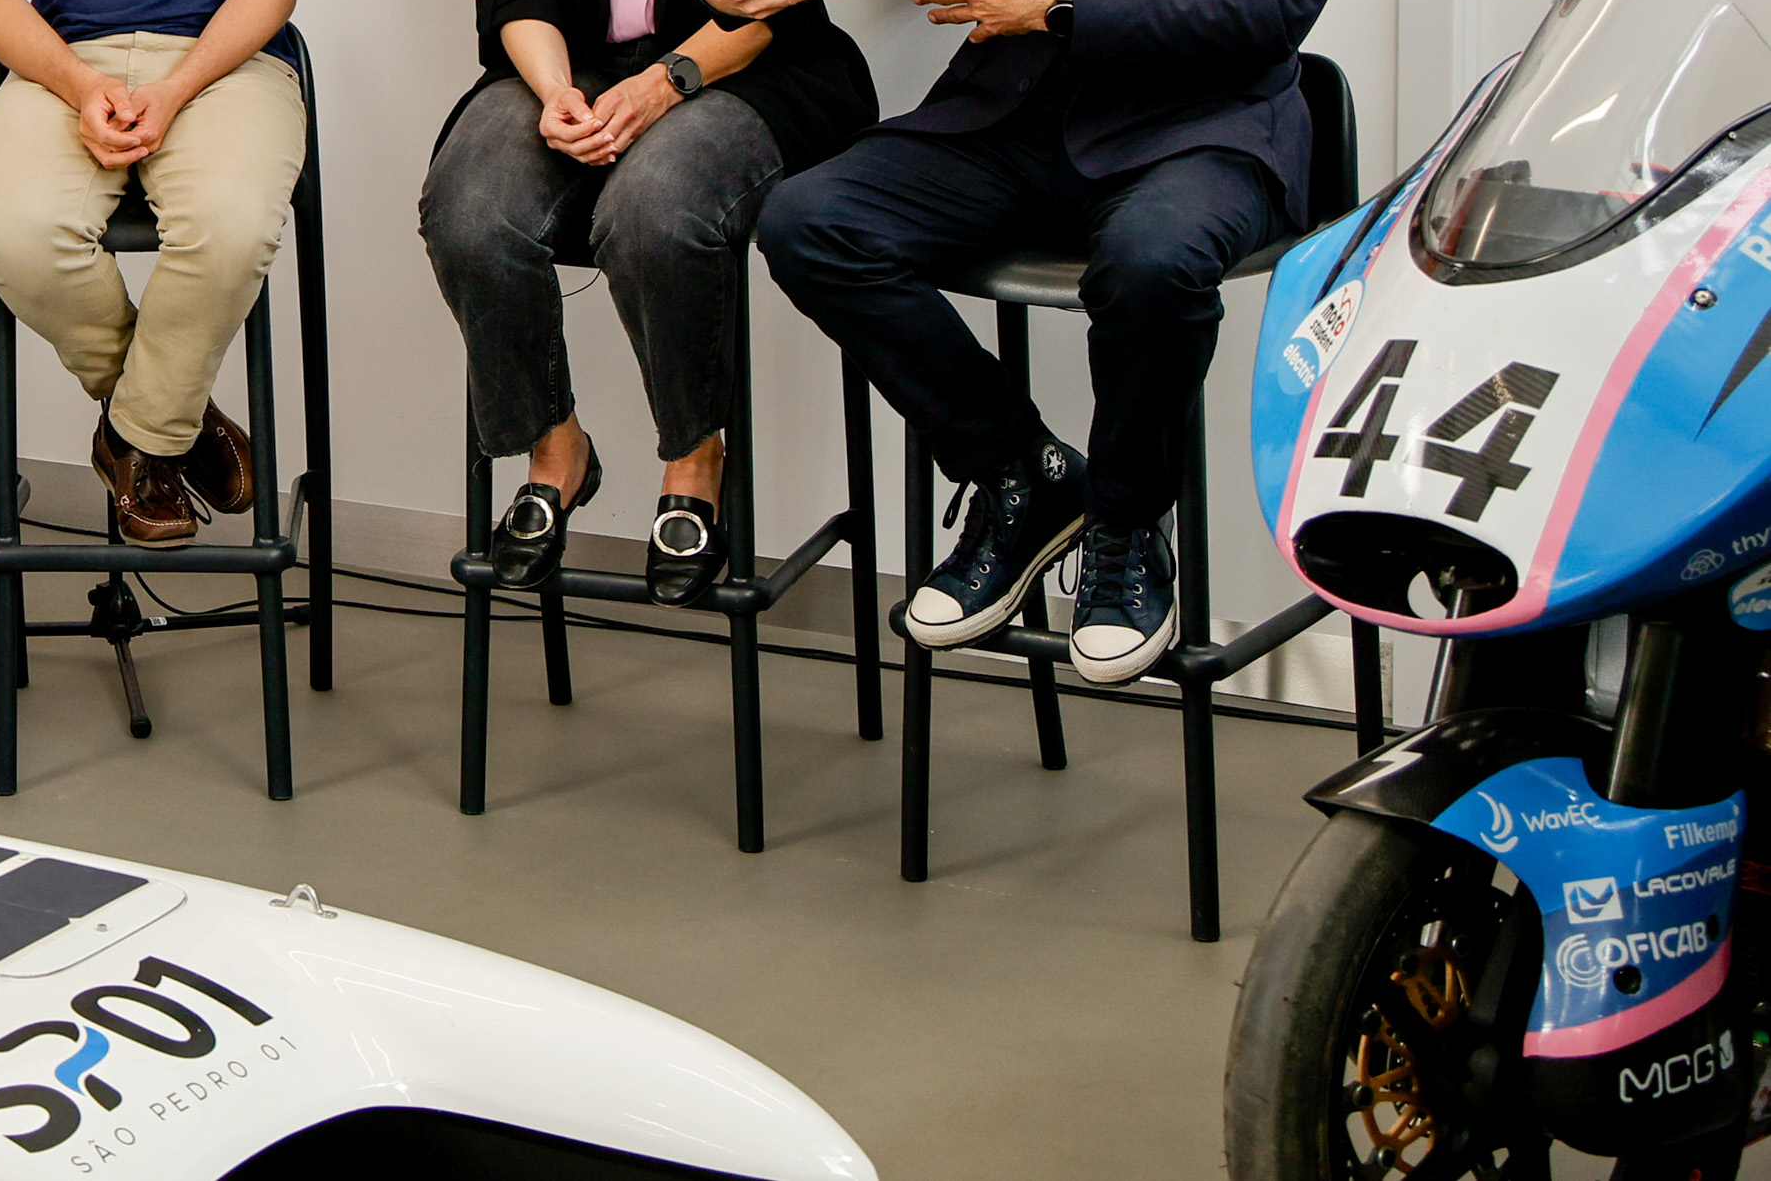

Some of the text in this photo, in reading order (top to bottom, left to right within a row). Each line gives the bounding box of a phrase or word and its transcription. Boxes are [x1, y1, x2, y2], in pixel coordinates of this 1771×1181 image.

[1309, 319, 1334, 353] student
[1320, 302, 1345, 336] moto
[1283, 343, 1317, 388] electric
[1313, 338, 1561, 523] 44
[1520, 801, 1600, 832] WavEC
[1664, 819, 1738, 850] Filkemp
[1619, 1044, 1714, 1104] MCG
[70, 1035, 298, 1174] SÃO PEDRO 01
